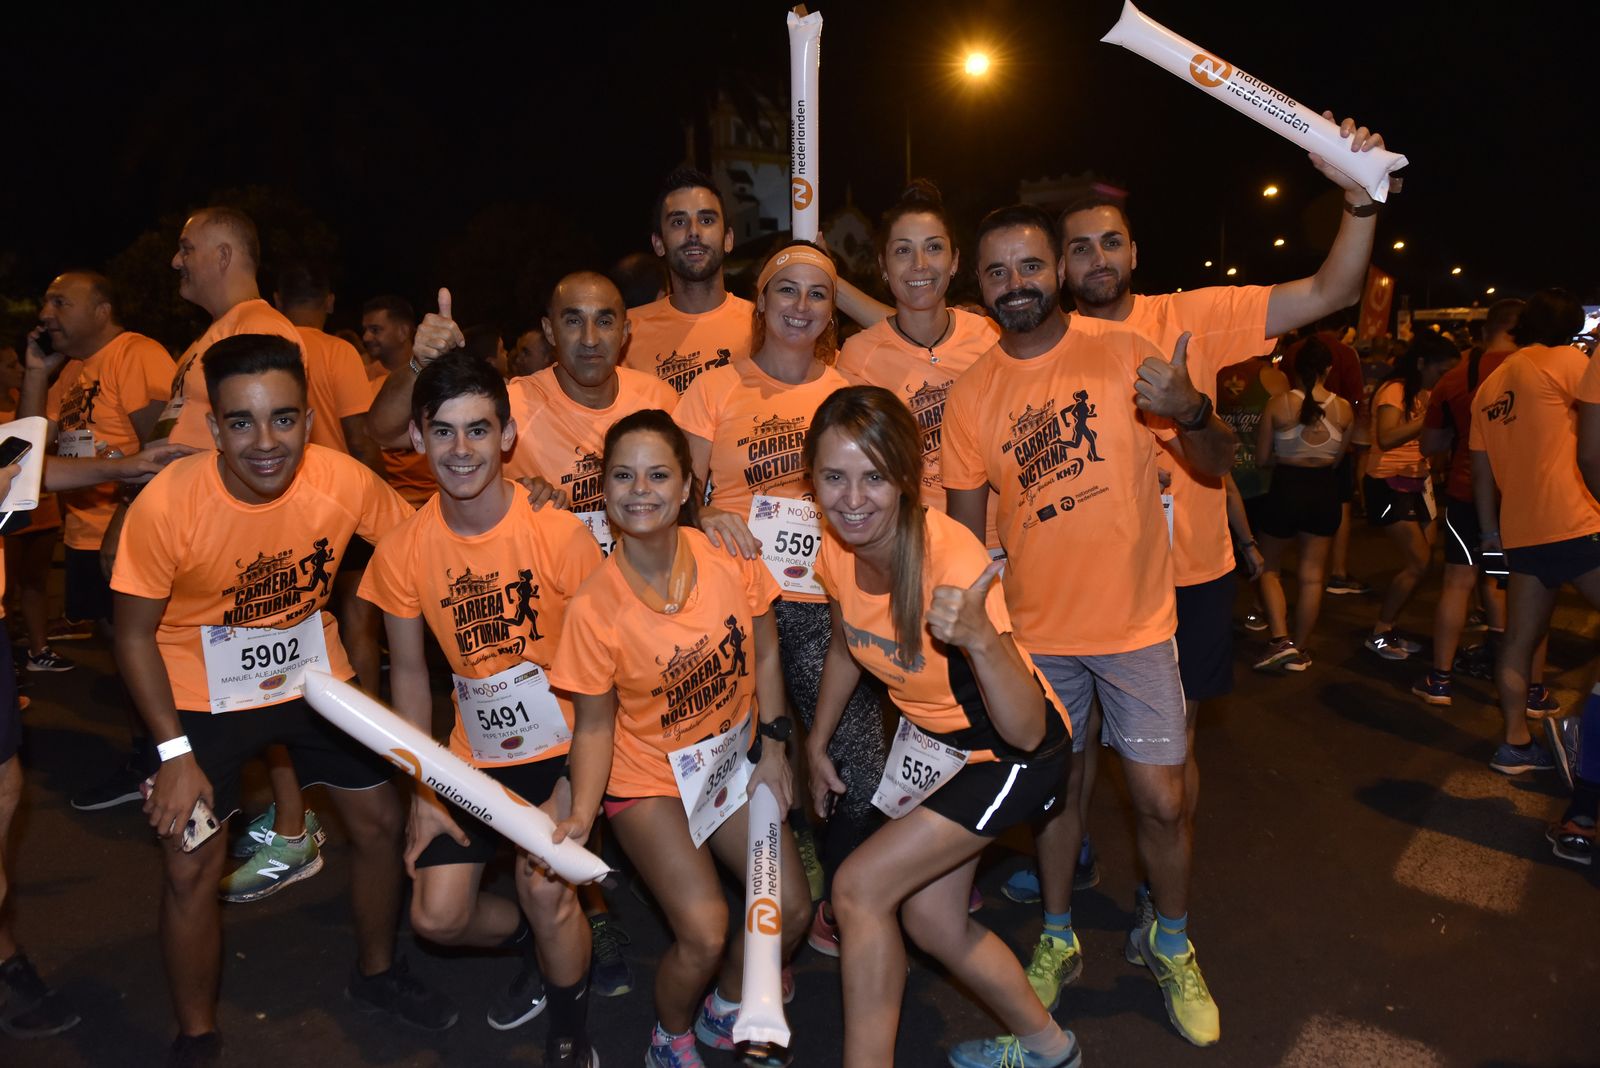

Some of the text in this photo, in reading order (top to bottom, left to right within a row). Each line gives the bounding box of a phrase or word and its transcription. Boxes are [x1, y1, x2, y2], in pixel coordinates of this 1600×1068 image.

[1227, 81, 1310, 134] nederlanden
[1235, 70, 1297, 108] nationale
[796, 100, 806, 175] nederlanden
[748, 429, 809, 462] CARRER
[1074, 485, 1100, 498] nationale
[1077, 486, 1110, 504] nederlanden
[762, 554, 785, 563] LAURA
[234, 566, 298, 607] CARRERA
[222, 590, 302, 626] NOCTURNA
[221, 655, 320, 684] MANUEL ALEJANDRO LOPEZ
[240, 637, 300, 671] 5902
[666, 652, 723, 709] CARRERA
[476, 700, 530, 731] 5491
[660, 675, 729, 729] NOCTURNA
[482, 723, 540, 740] PEPE TATAY RUFO
[705, 751, 738, 796] 3590
[901, 755, 941, 792] 5536
[426, 776, 494, 823] nationale
[752, 839, 764, 896] nationale
[765, 821, 777, 897] nederlanden
